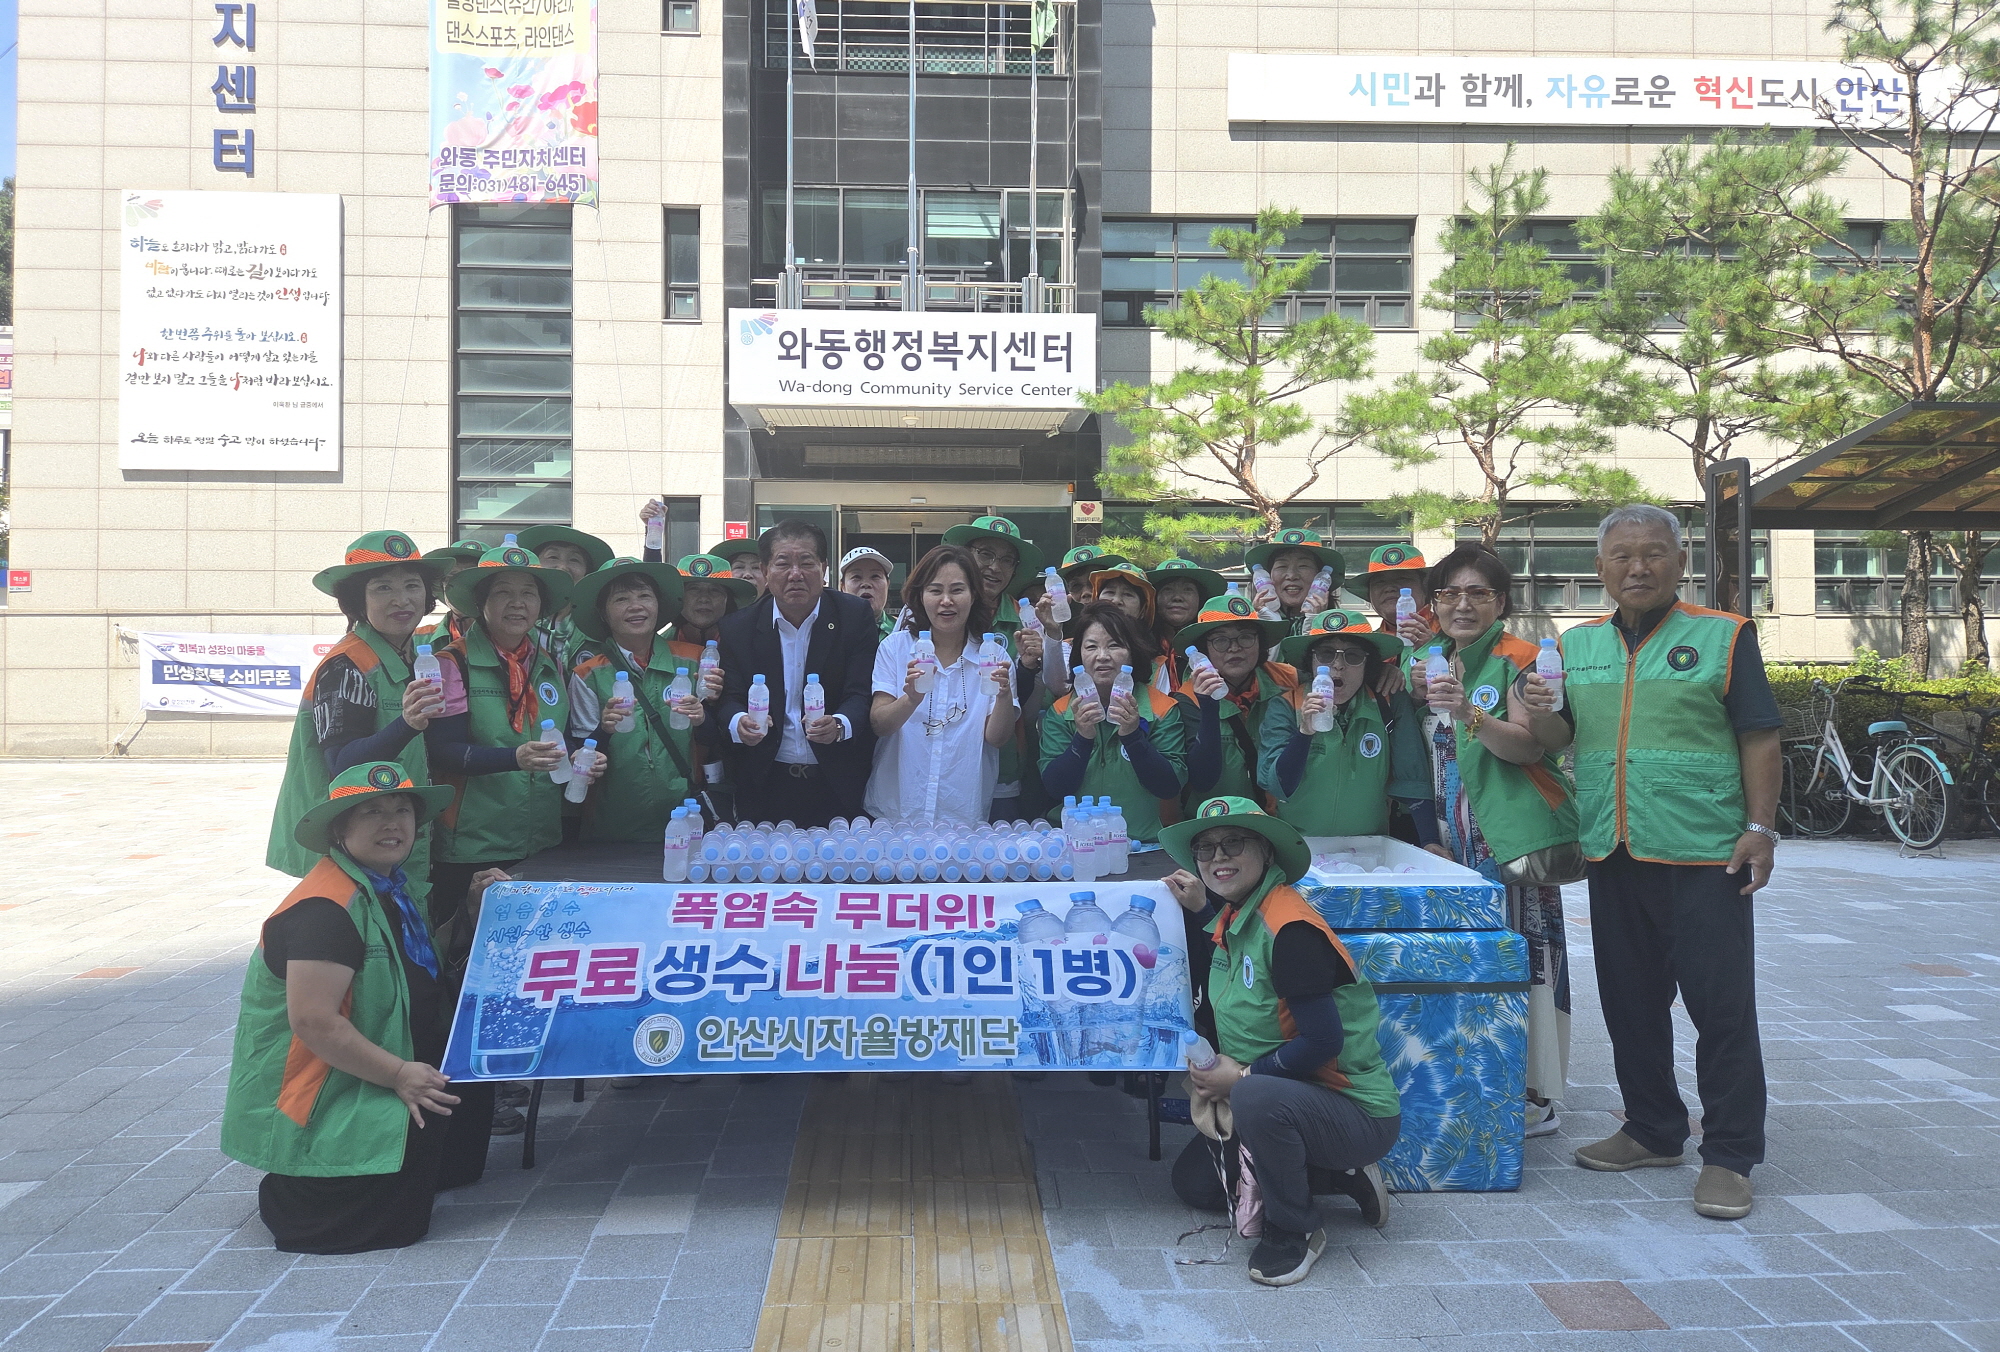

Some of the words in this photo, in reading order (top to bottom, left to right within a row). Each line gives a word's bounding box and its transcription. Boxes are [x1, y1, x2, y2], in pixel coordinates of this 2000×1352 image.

[446, 20, 520, 49] 댄스스포츠,
[524, 22, 574, 48] 라인댄스
[1349, 72, 1446, 108] 시민과
[1460, 73, 1533, 108] 함께,
[1546, 74, 1676, 109] 자유로운
[1693, 76, 1818, 110] 혁신도시
[1835, 77, 1903, 113] 안산
[440, 147, 477, 167] 와동
[483, 146, 586, 169] 주민자치센터
[206, 290, 226, 299] 다시
[161, 350, 179, 361] 다른
[183, 350, 224, 363] 사람들이
[778, 328, 1072, 373] 와동행정복지센터
[174, 372, 195, 385] 말고
[779, 379, 853, 395] Wa-dong
[860, 381, 952, 398] Community
[958, 383, 1014, 396] Service
[1021, 383, 1073, 397] Center
[178, 643, 206, 655] 회복과
[207, 645, 235, 656] 성장의
[237, 645, 266, 657] 마중물
[163, 664, 226, 684] 민생회복
[227, 669, 292, 686] 소비쿠폰
[672, 892, 818, 930] 폭염속
[836, 893, 996, 931] 무더위!
[557, 921, 591, 940] 생수
[523, 948, 640, 1002] 무료
[653, 945, 768, 996] 생수
[786, 944, 900, 994] 나눔
[910, 944, 1014, 996] (1인
[1033, 948, 1137, 999] 1병)
[699, 1016, 1019, 1058] 안산시자율방재단
